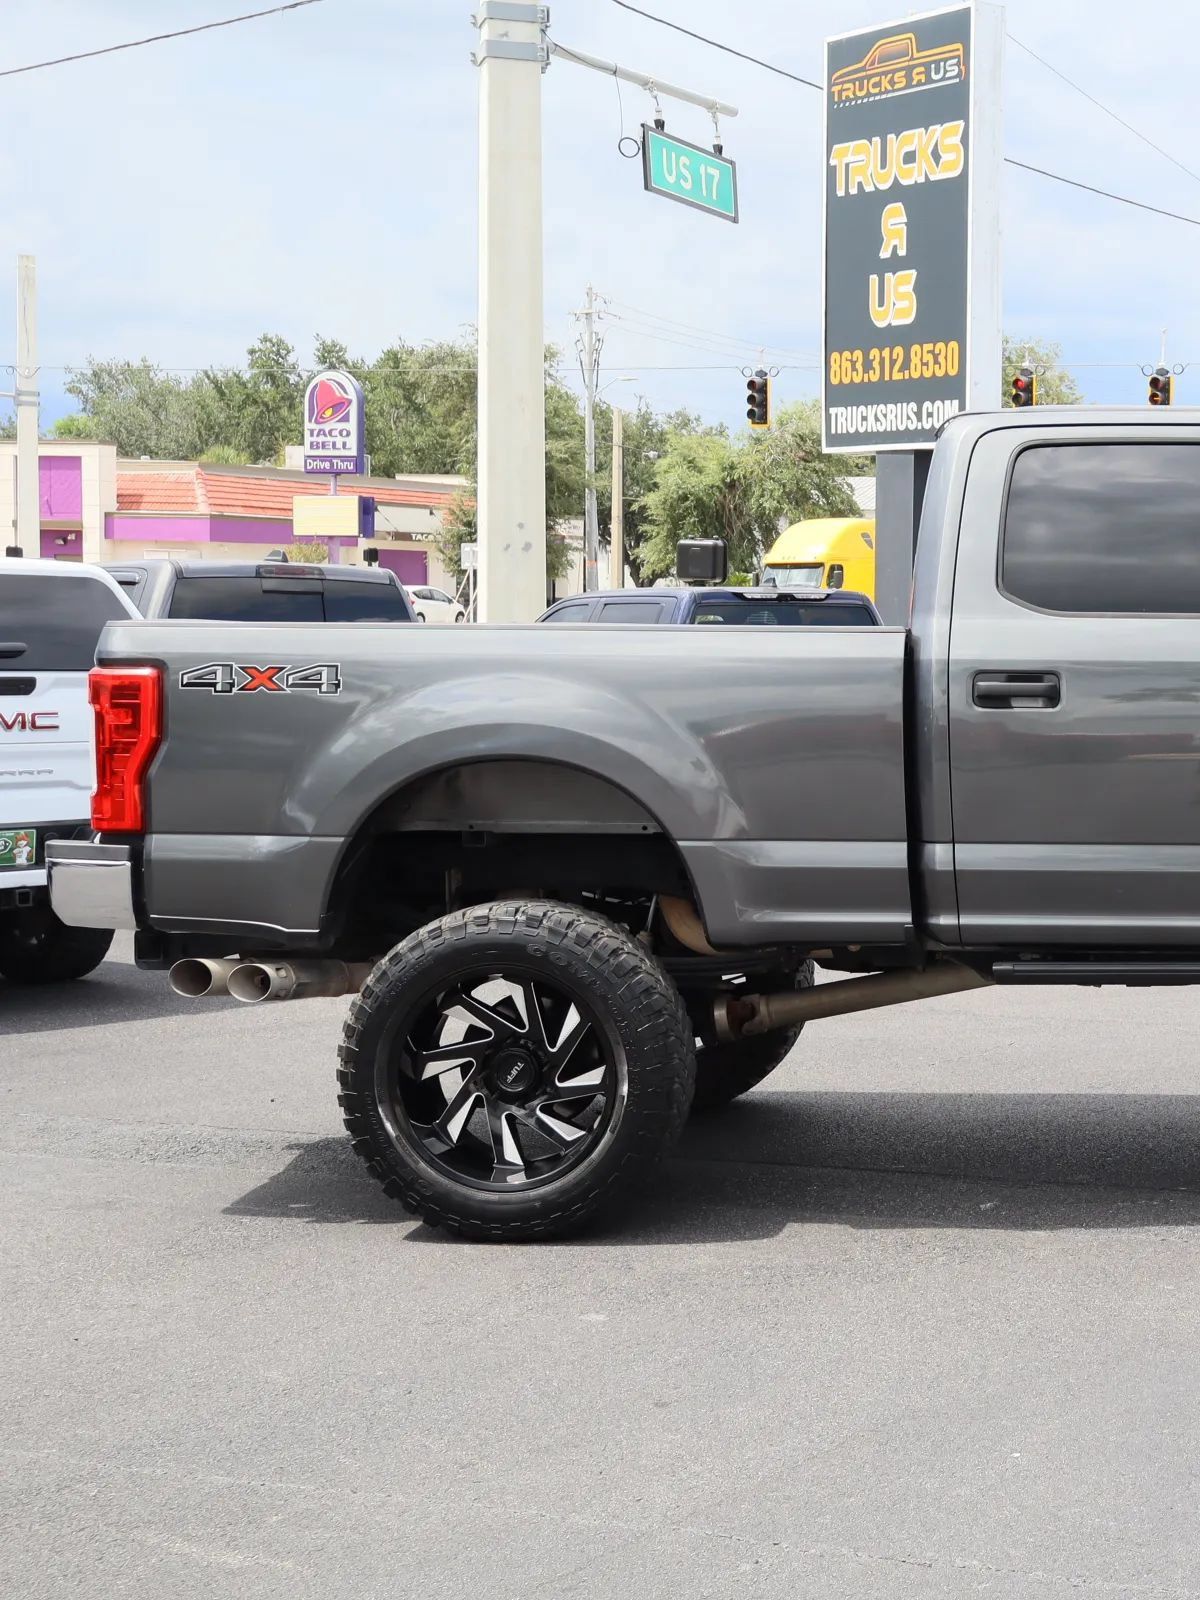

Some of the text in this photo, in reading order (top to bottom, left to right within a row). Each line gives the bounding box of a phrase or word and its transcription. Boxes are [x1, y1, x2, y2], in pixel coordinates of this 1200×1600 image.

[831, 70, 906, 101] TRUCKS
[930, 58, 959, 80] US
[662, 147, 720, 200] US 17
[830, 120, 965, 196] TRUCKS
[869, 270, 917, 327] US
[830, 340, 959, 385] 863.312.8530
[307, 428, 351, 438] TACO
[829, 399, 959, 434] TRUCKSRUS.COM
[306, 459, 354, 470] Drive Thru
[309, 440, 352, 450] BELL
[0, 712, 60, 731] MC
